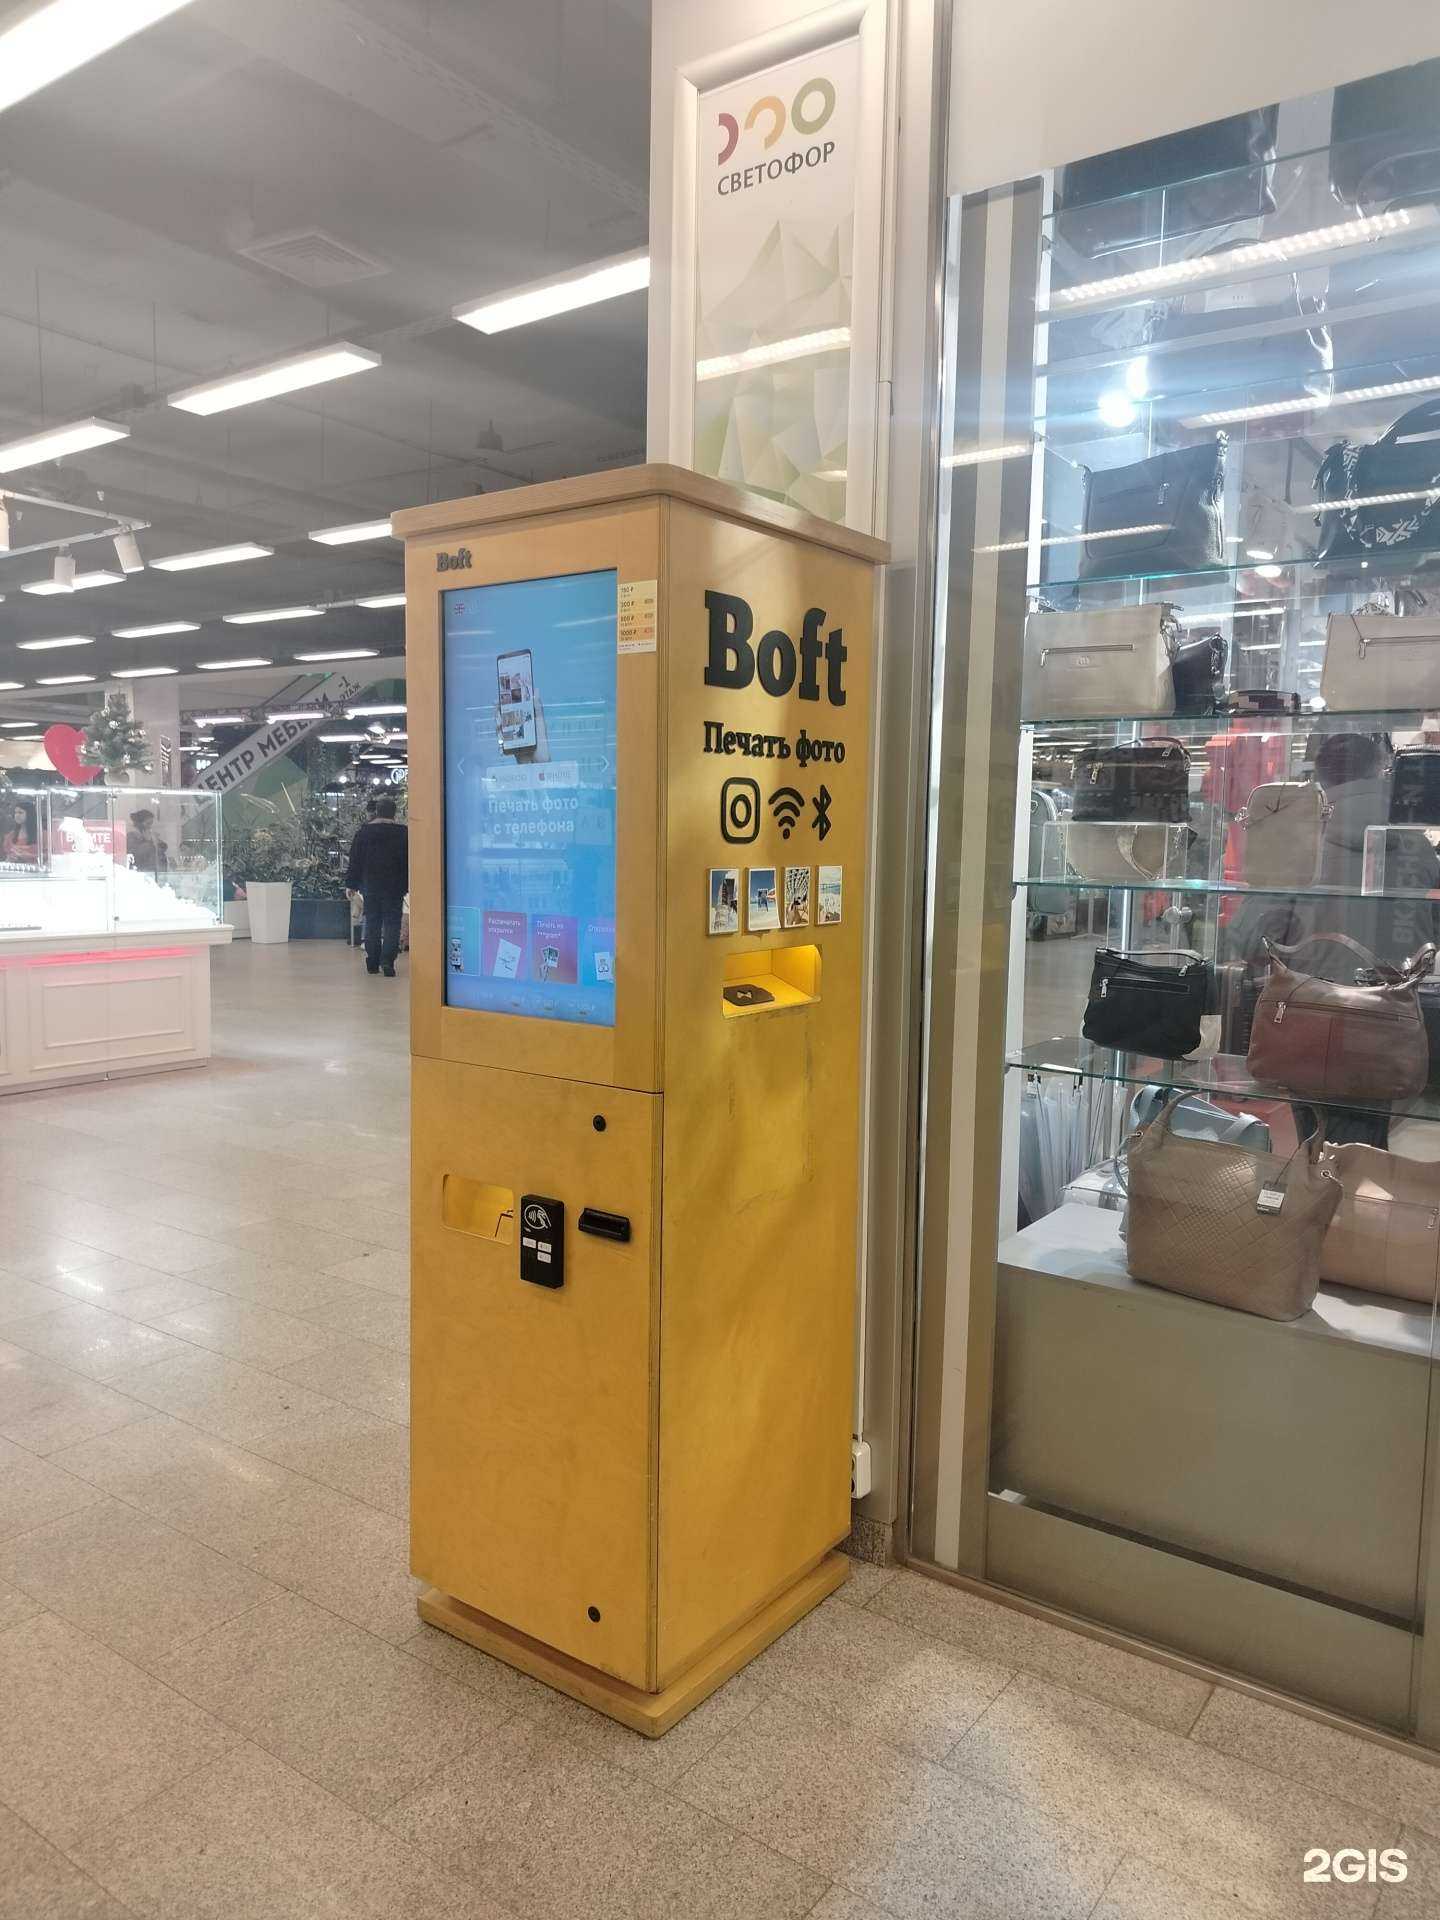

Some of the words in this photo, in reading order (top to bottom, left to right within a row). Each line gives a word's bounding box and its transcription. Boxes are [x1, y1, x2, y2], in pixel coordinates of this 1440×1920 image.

[717, 141, 836, 196] СВЕТОФОР
[436, 547, 473, 573] Boft
[704, 589, 848, 707] Boft
[703, 720, 791, 760] Печать
[796, 729, 846, 768] фото
[488, 798, 538, 814] Печать
[542, 796, 579, 814] фото
[504, 819, 575, 836] телефона
